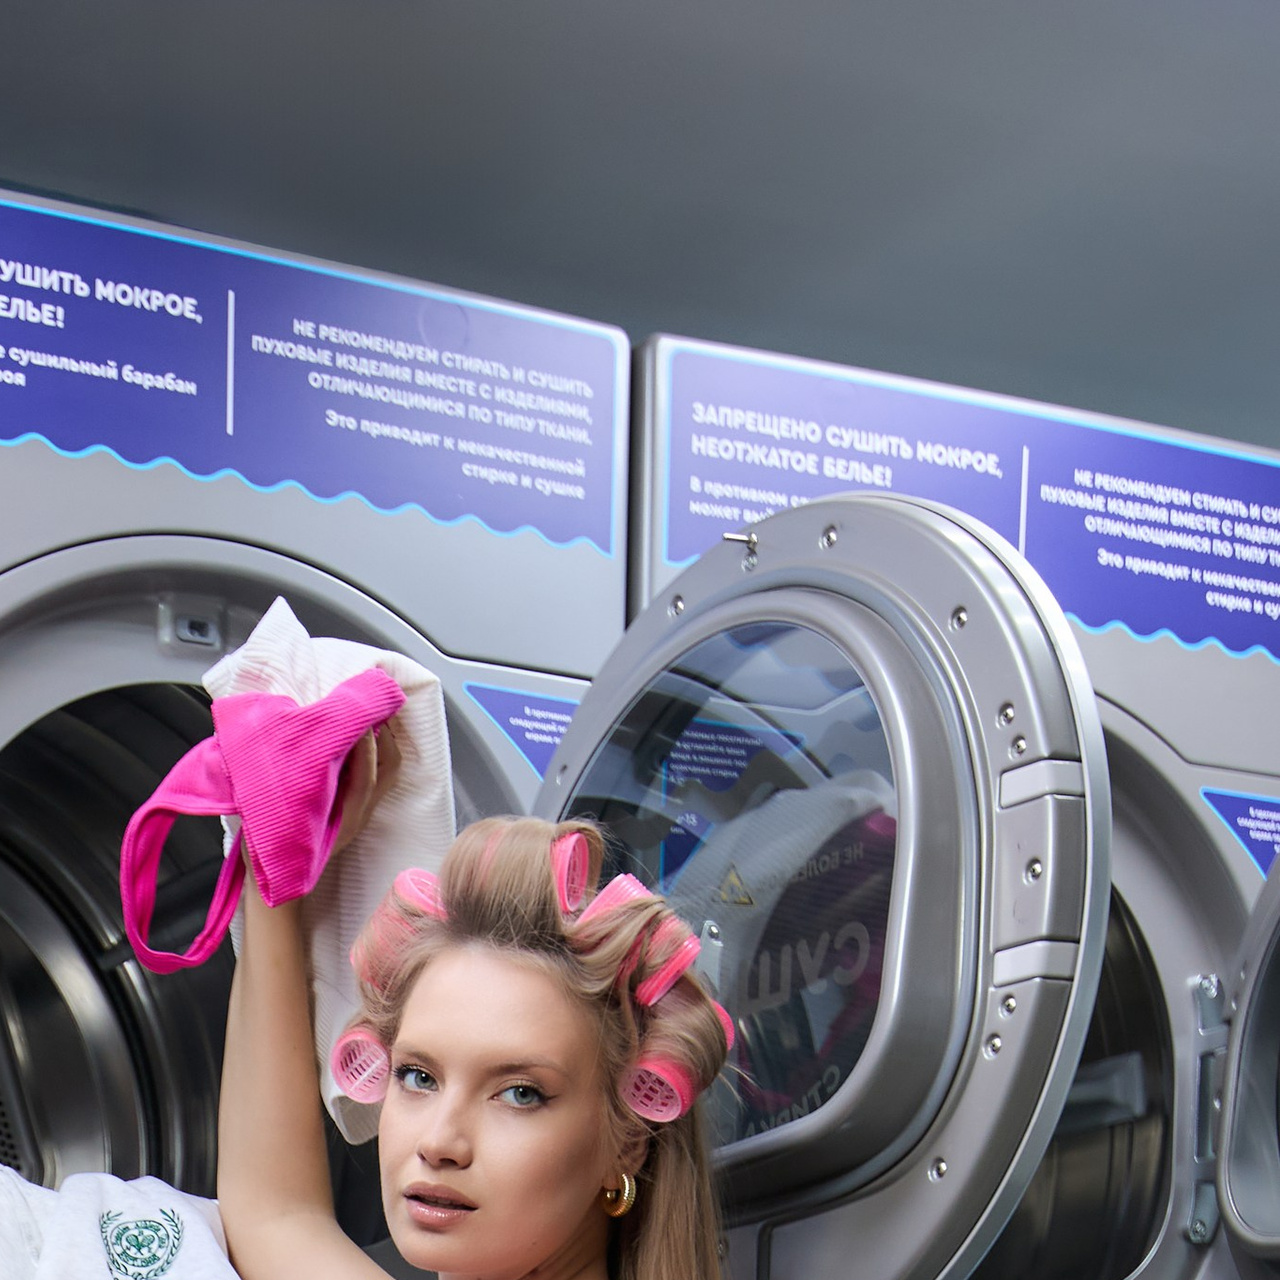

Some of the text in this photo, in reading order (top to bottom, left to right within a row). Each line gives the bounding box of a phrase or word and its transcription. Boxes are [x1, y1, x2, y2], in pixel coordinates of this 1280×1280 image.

[95, 279, 202, 323] МОКРОЕ,
[9, 347, 118, 380] сушильный
[122, 365, 196, 395] барабан
[294, 319, 593, 398] НЕ РЕКОМЕНДУЕМ СТИРАТЬ И СУШИТЬ
[693, 402, 1002, 478] ЗАПРЕЩЕНО СУШИТЬ МОКРОЕ,
